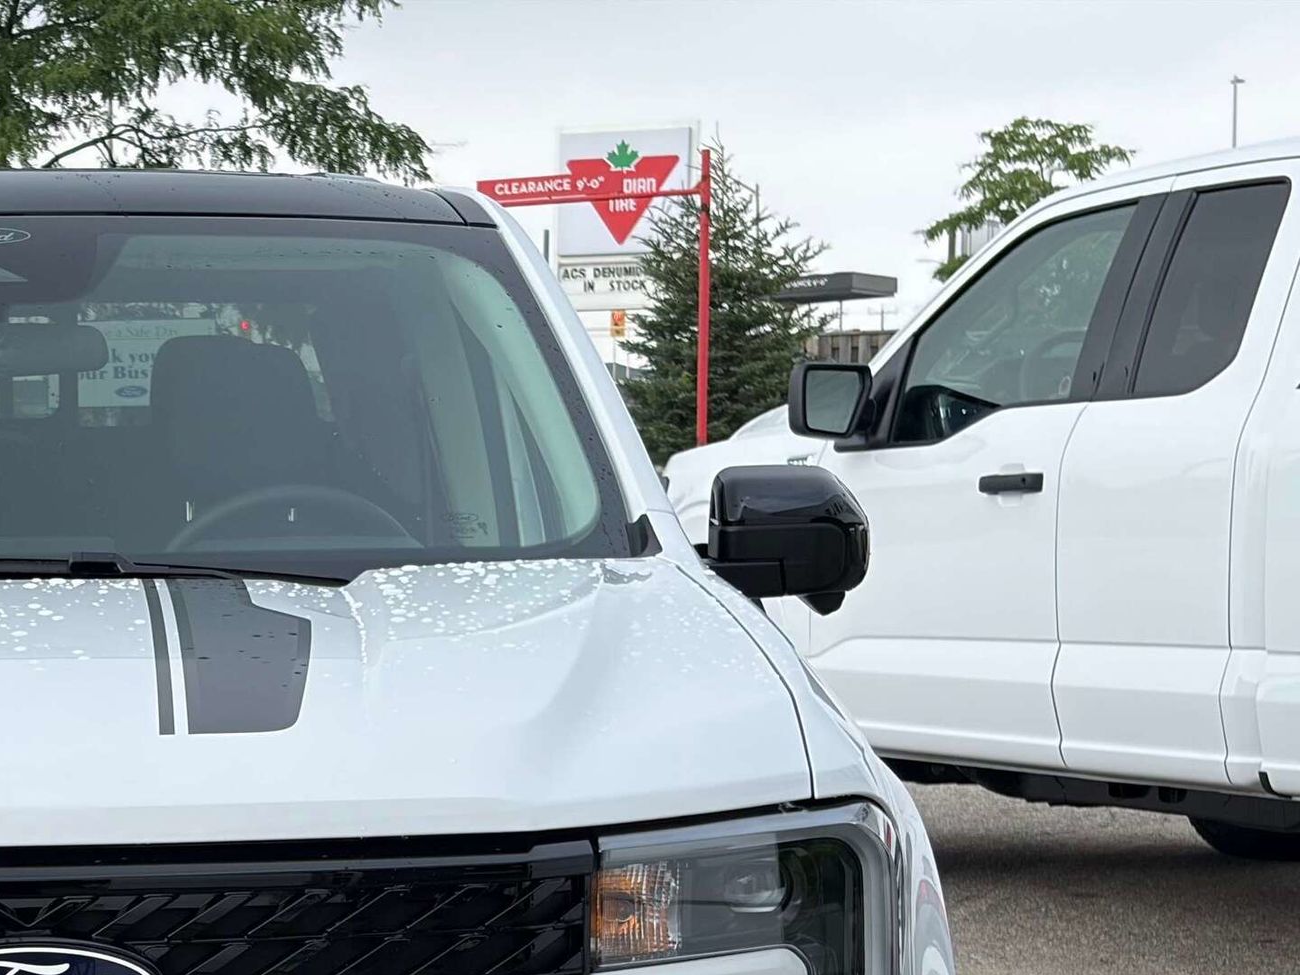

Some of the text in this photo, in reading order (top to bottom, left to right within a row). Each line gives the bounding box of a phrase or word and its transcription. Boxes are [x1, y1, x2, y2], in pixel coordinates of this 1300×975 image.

[494, 178, 572, 195] CLEARANCE
[623, 177, 657, 194] DIAN
[562, 268, 586, 280] ACS
[583, 279, 646, 293] IN STOCK
